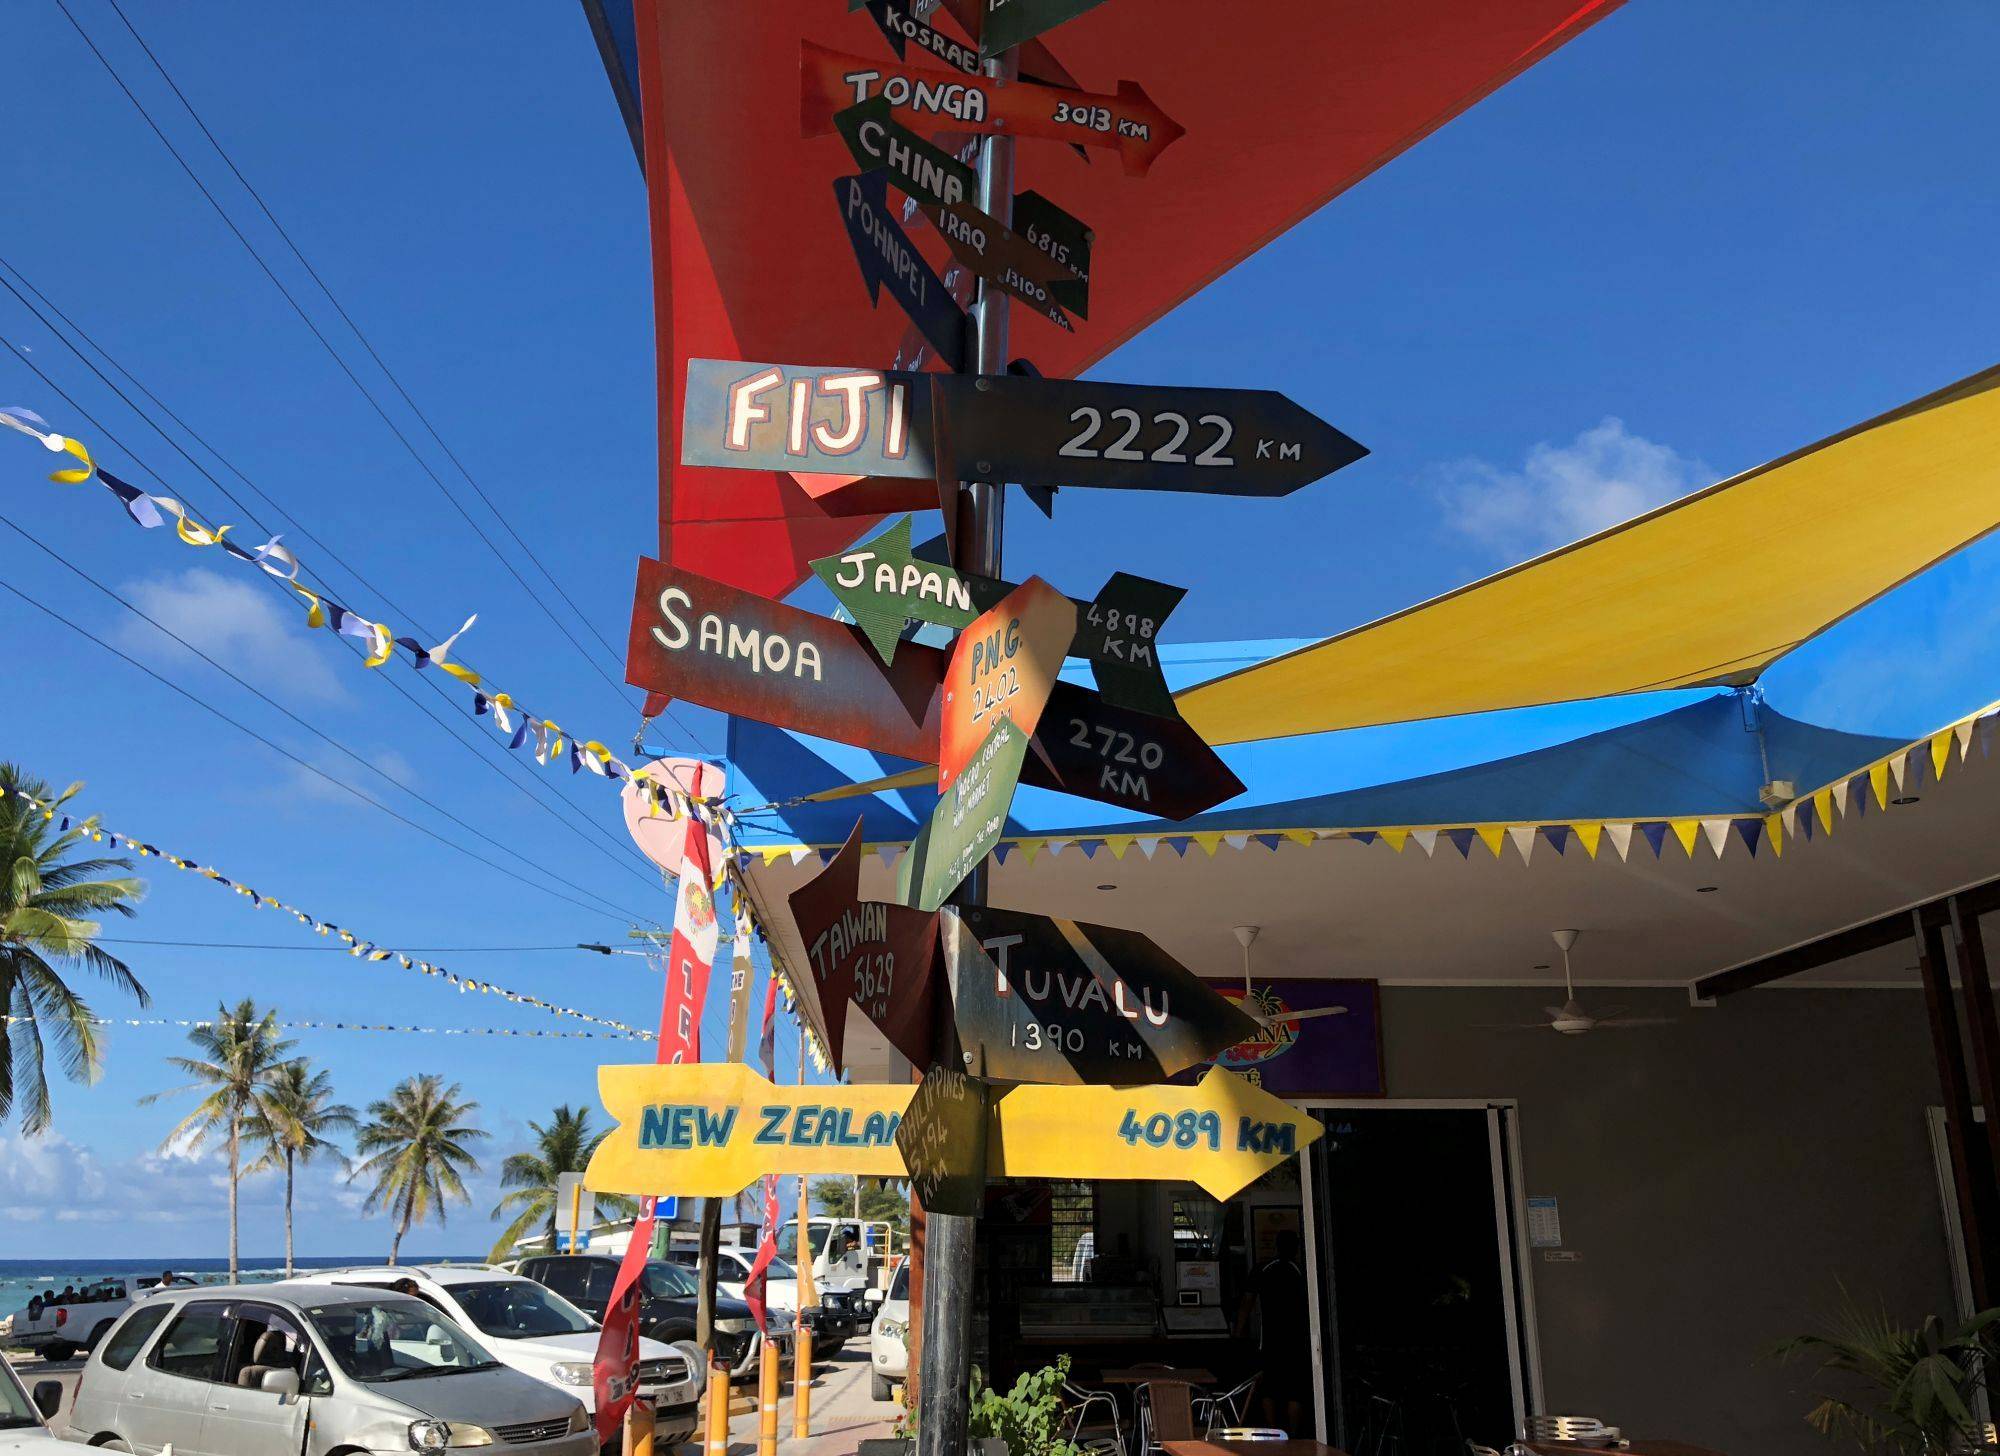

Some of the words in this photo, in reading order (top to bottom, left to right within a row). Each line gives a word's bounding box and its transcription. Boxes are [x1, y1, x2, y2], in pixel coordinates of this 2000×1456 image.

[886, 4, 978, 74] KOSRAE
[845, 71, 985, 122] TONGA
[1053, 102, 1111, 131] 3013
[1118, 118, 1150, 141] KM
[859, 120, 963, 205] CHINA
[848, 179, 926, 306] POHNPEI
[939, 209, 986, 255] IRAQ
[1026, 224, 1070, 263] 6815
[725, 367, 910, 459] FIJI
[1059, 406, 1234, 467] 2222
[1255, 438, 1301, 462] KM
[835, 551, 972, 612] JAPAN
[650, 586, 822, 682] SAMOA
[1086, 603, 1154, 639] 4898
[971, 618, 1023, 685] P.N.G.
[1102, 636, 1152, 668] KM
[972, 665, 1020, 724] 2402
[982, 726, 1010, 767] CENTRAL
[1069, 718, 1163, 770] 2720
[1100, 764, 1151, 801] KM
[810, 902, 887, 980] TAIWAN
[854, 952, 894, 1003] 5629
[981, 933, 1169, 1027] TUVALU
[871, 1000, 887, 1019] KM
[1011, 1021, 1085, 1052] 1390
[1109, 1039, 1143, 1060] KM
[639, 1104, 740, 1149] NEW
[753, 1104, 901, 1147] ZEALA
[1118, 1108, 1221, 1152] 4089
[1236, 1115, 1297, 1154] KM
[897, 1065, 966, 1153] PHILIPPINES
[923, 1157, 948, 1206] KM
